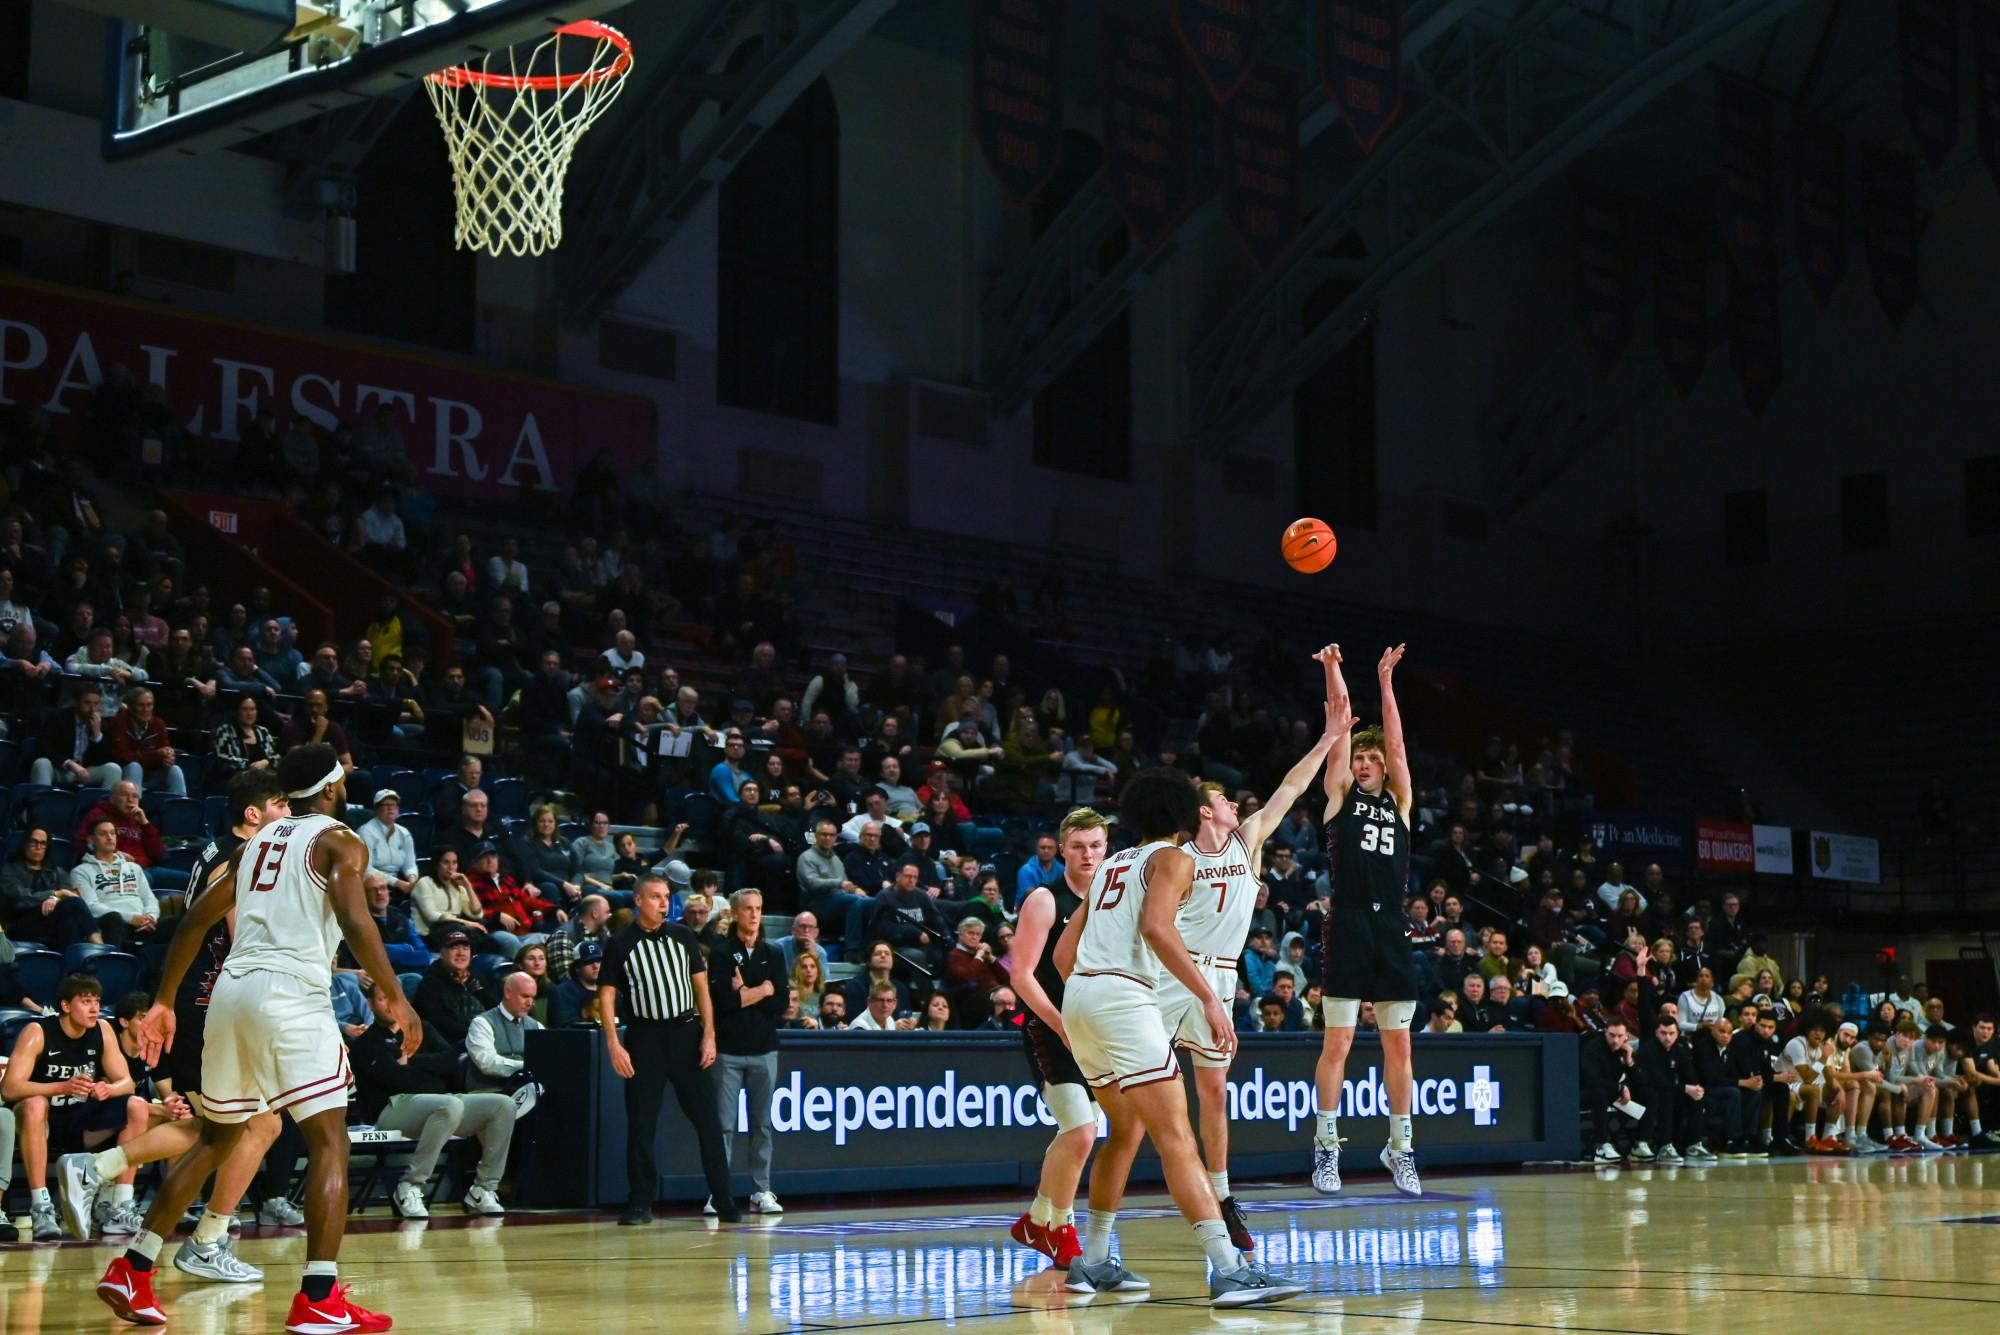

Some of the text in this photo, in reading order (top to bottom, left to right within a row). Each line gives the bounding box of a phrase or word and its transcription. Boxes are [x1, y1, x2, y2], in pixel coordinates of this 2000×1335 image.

[1353, 801, 1396, 823] PENN
[1360, 824, 1395, 856] 35
[1698, 839, 1711, 859] GO
[250, 841, 288, 891] 13
[1192, 864, 1246, 881] ARVARD
[1095, 865, 1132, 911] 15
[1210, 883, 1227, 913] 7
[1203, 955, 1212, 965] H
[361, 1132, 389, 1142] PENN
